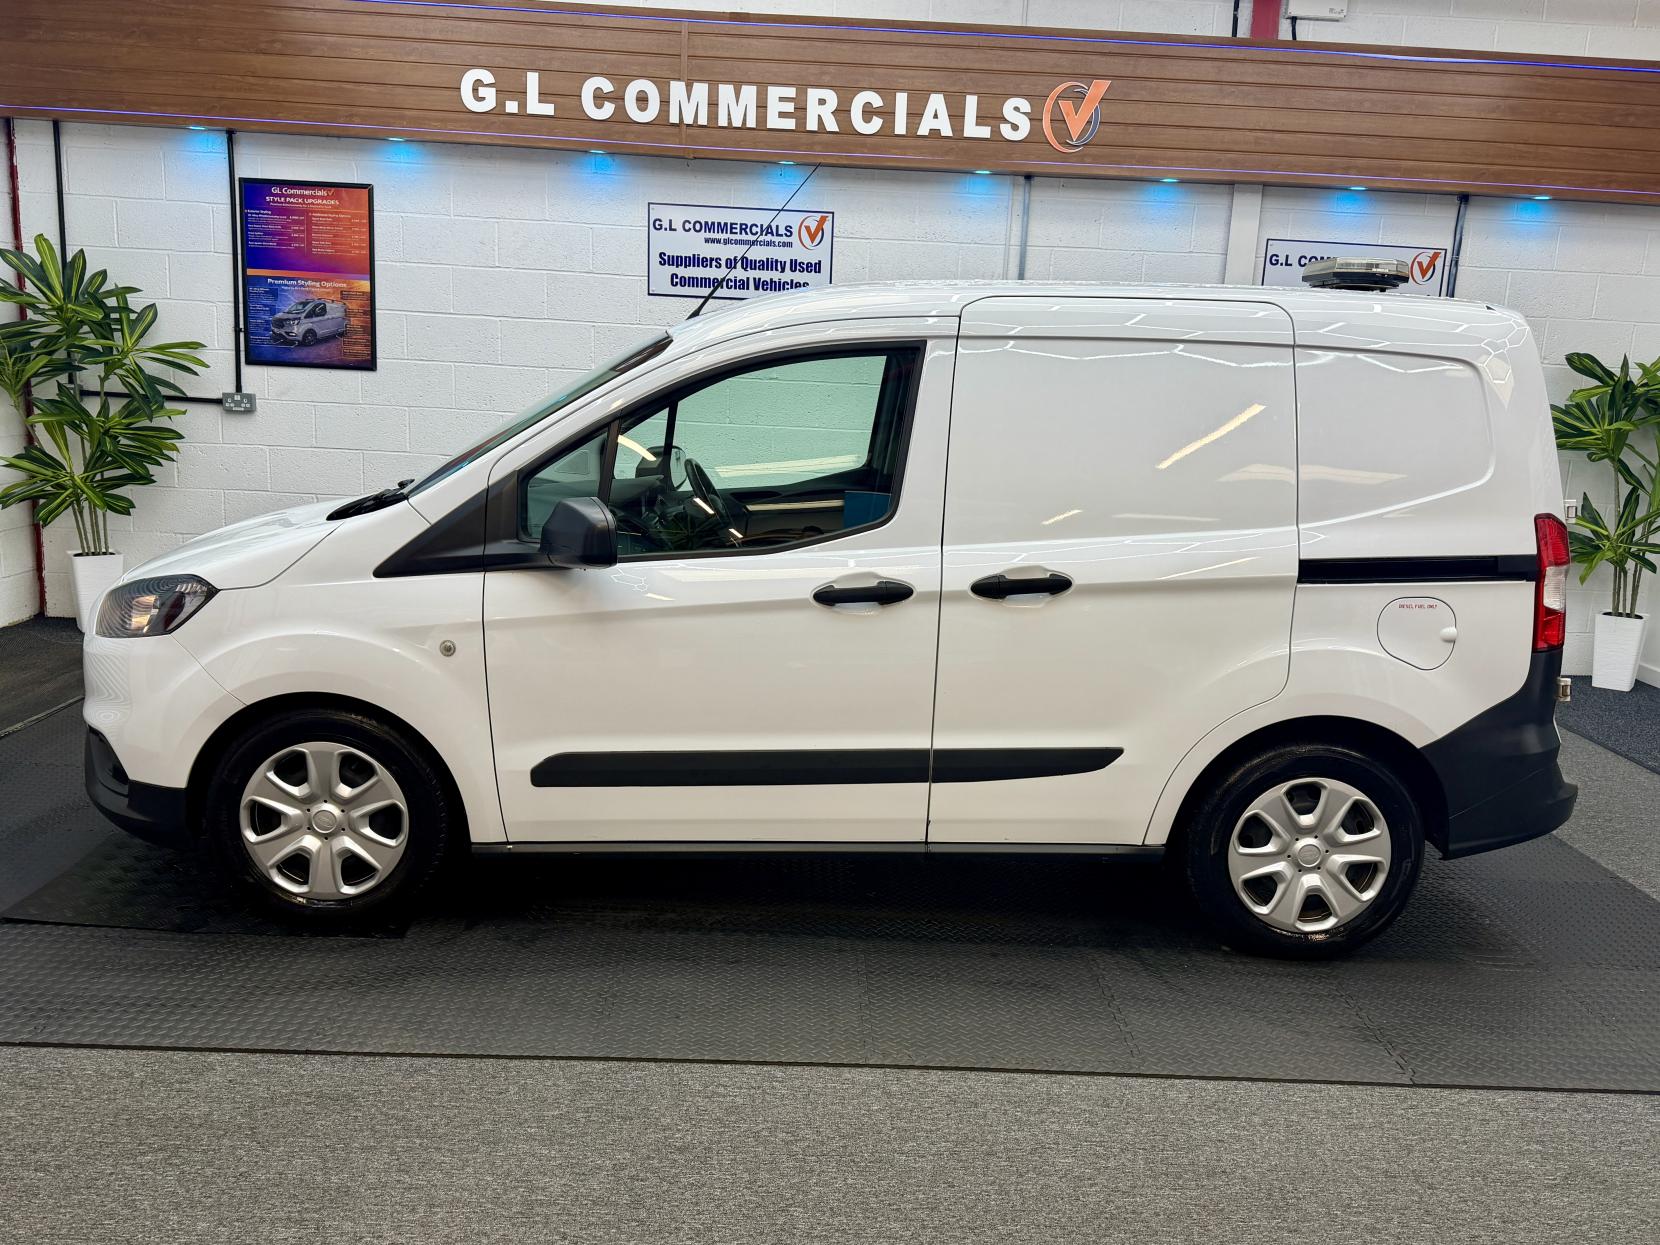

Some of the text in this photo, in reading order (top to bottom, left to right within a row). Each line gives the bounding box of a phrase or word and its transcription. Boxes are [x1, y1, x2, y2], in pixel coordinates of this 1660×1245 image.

[459, 68, 1032, 141] G.L COMMERCIALS
[271, 186, 328, 196] GL Commercials
[652, 217, 793, 237] G.L COMMERCIALS
[658, 251, 822, 274] Suppliers of Quality Used
[1268, 253, 1293, 267] G.L
[297, 279, 320, 288] Styling
[670, 273, 750, 290] Commercial
